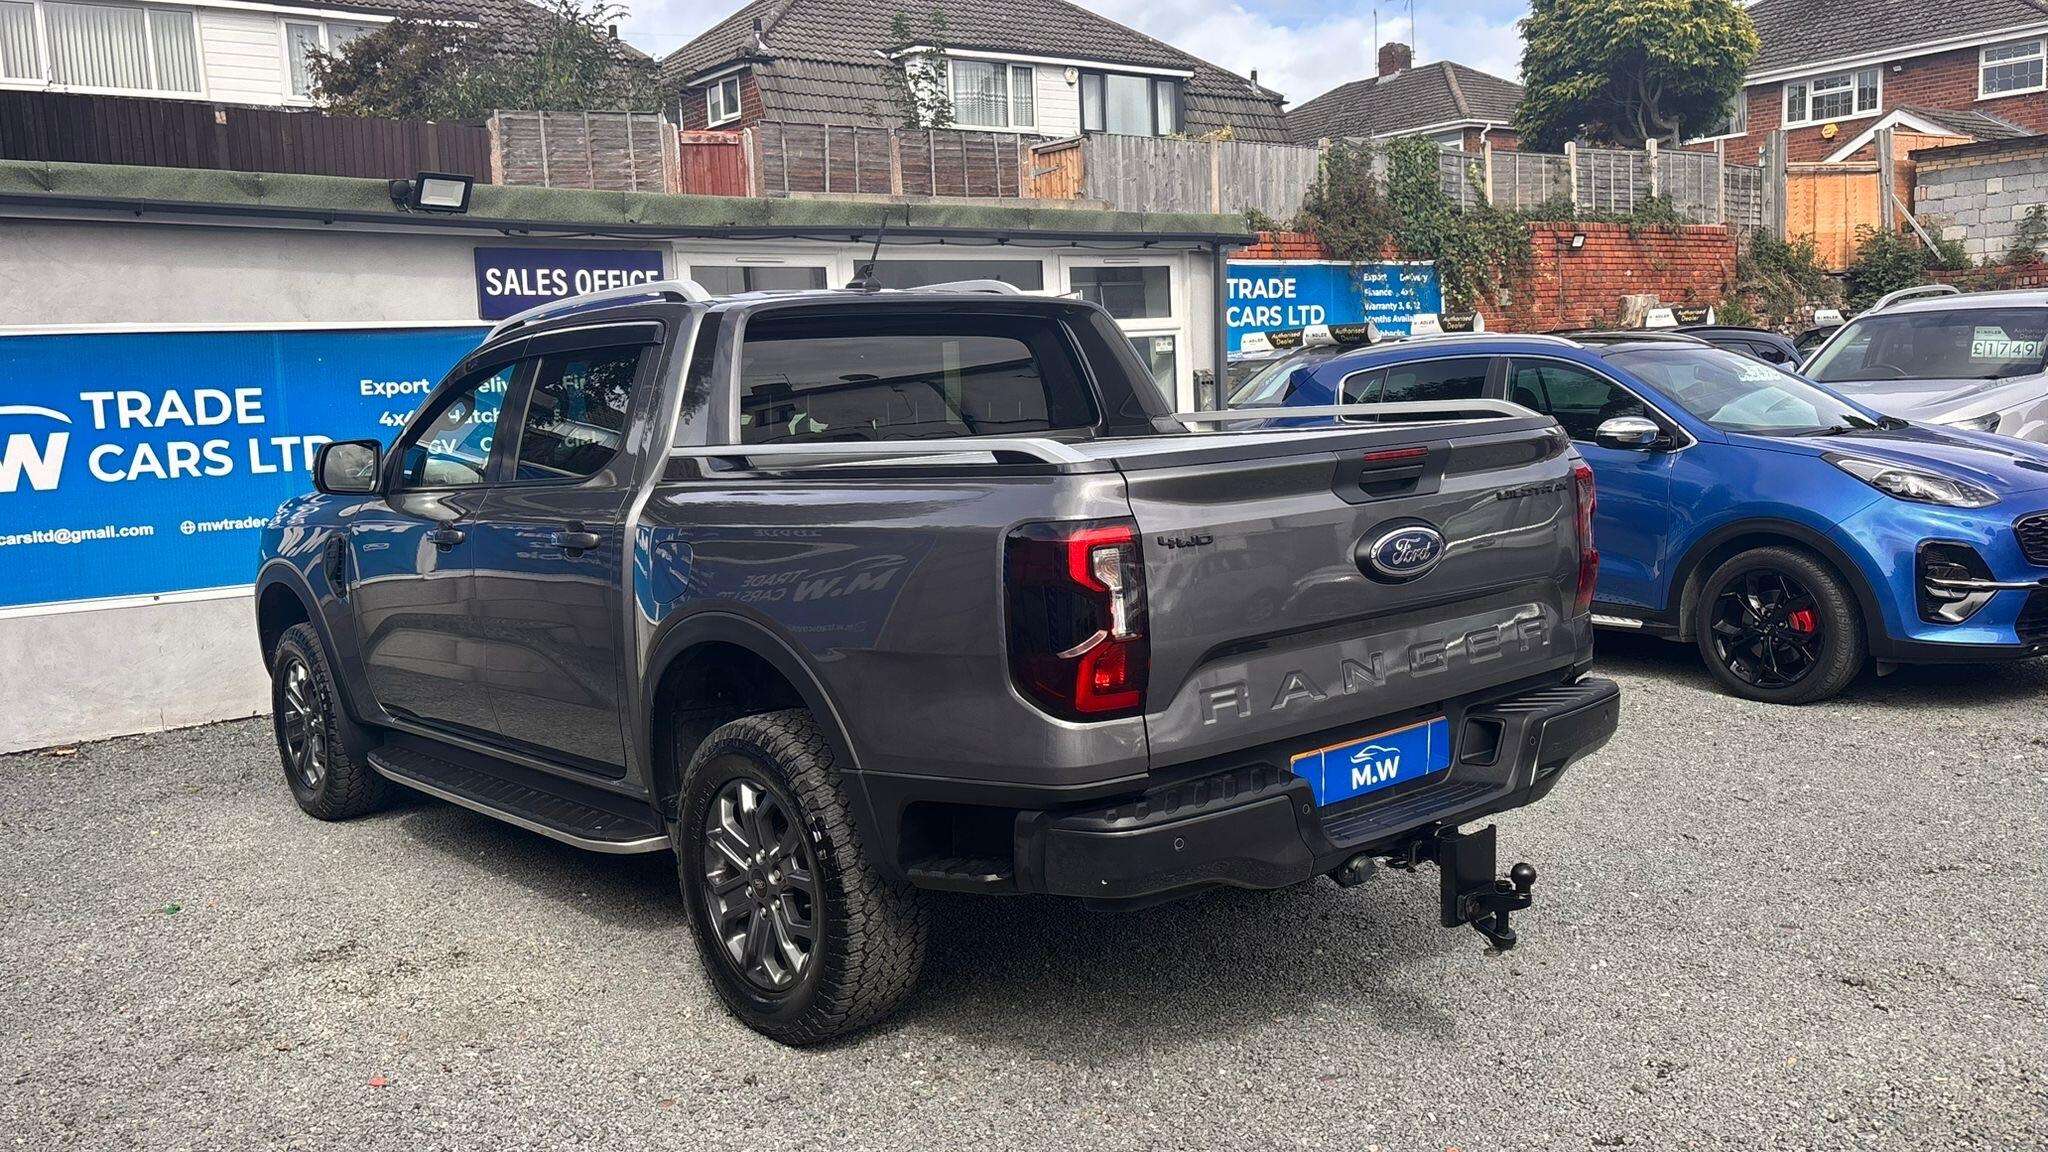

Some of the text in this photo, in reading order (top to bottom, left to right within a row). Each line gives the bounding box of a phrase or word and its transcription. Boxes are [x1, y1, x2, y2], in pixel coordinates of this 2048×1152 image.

[486, 268, 568, 297] SALES
[1226, 278, 1297, 299] TRADE
[1363, 273, 1387, 283] Export
[1226, 305, 1325, 327] CARS LTD
[1365, 302, 1397, 311] Warranty
[1364, 314, 1391, 323] Months
[360, 378, 431, 398] Export
[80, 387, 265, 430] TRADE
[89, 439, 234, 483] CARS
[1157, 535, 1214, 550] 4WD
[1392, 537, 1432, 565] Ford
[1202, 611, 1552, 726] RANGER
[1351, 754, 1401, 791] M.W
